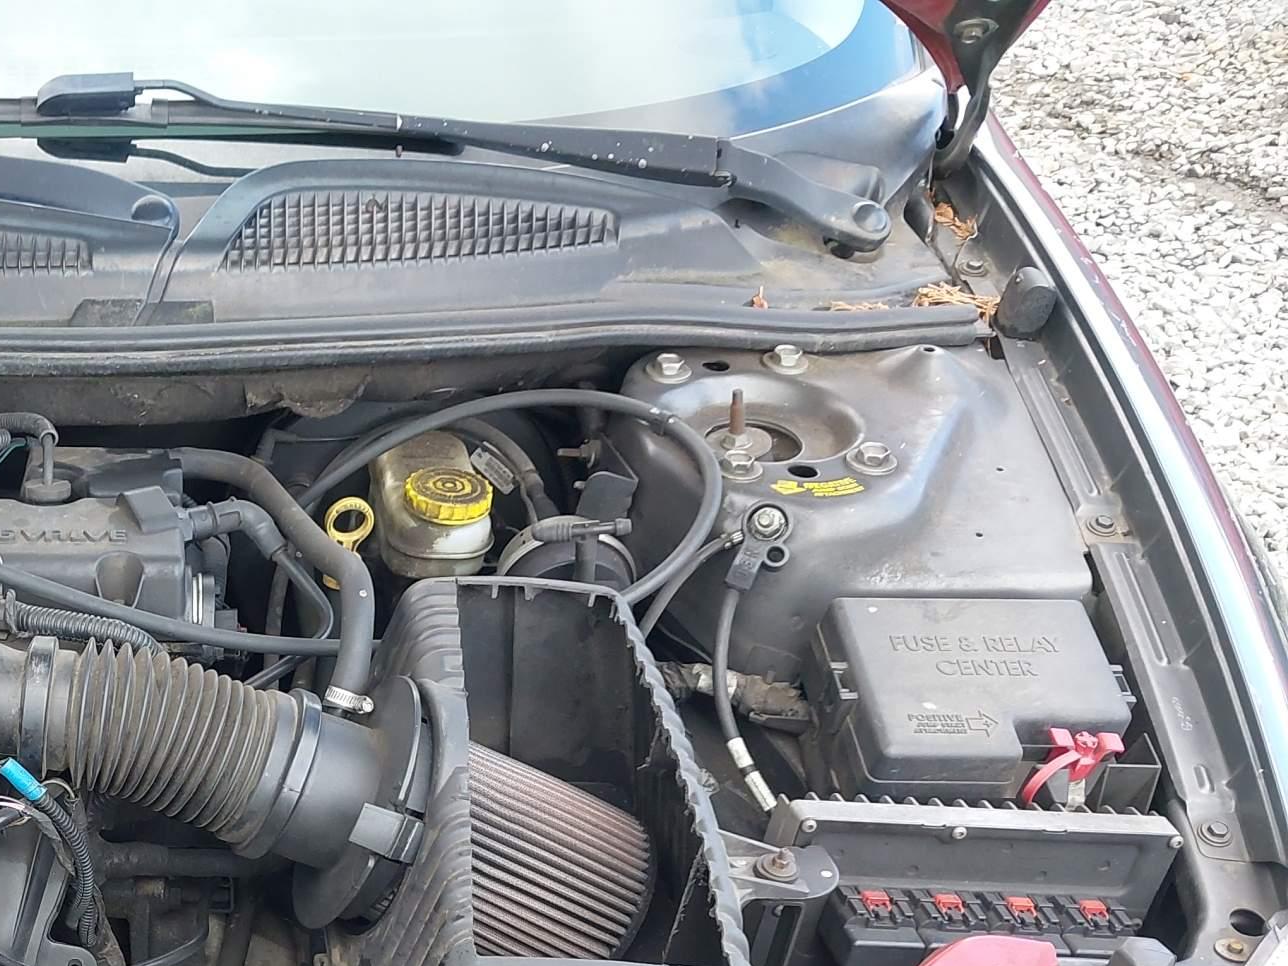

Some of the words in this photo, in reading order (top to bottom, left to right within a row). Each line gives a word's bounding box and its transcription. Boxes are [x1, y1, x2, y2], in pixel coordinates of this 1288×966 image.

[20, 529, 129, 542] VALVE
[889, 634, 952, 652] FUSE
[958, 636, 979, 652] &
[982, 635, 1061, 653] RELAY
[935, 659, 1039, 677] CENTER
